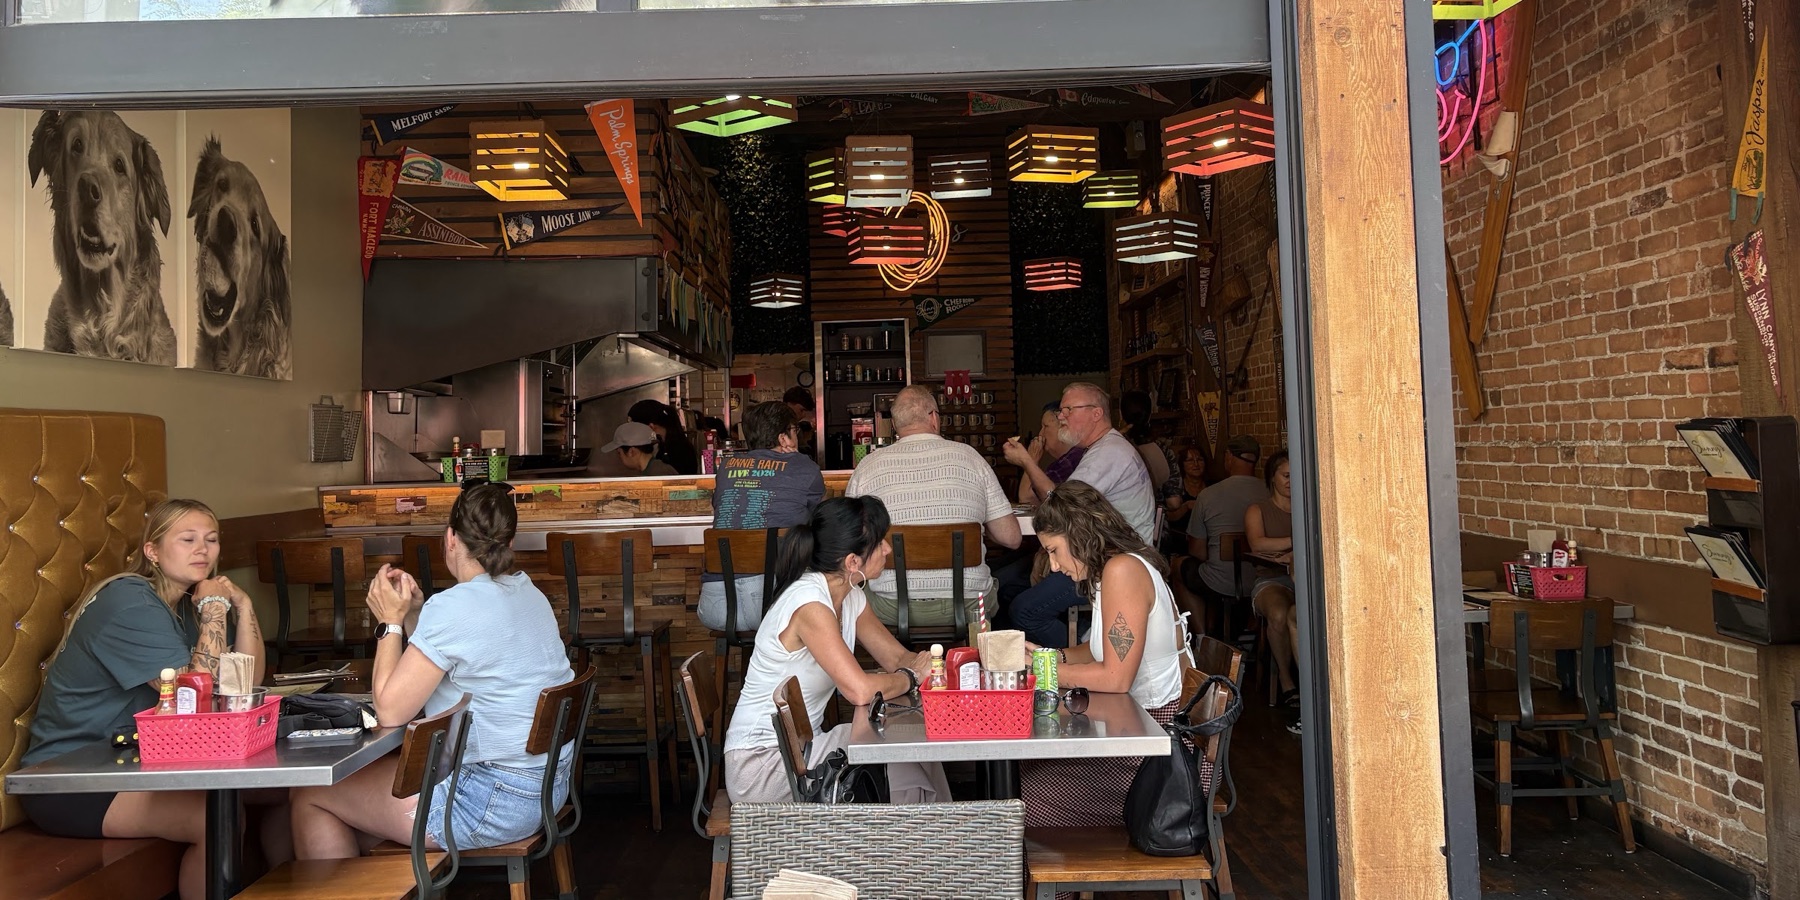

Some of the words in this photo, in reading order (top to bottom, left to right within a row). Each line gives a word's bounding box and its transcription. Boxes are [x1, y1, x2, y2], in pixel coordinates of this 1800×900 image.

[391, 111, 433, 132] MELFORT
[599, 105, 626, 142] Palm
[1746, 79, 1765, 146] Jasper
[610, 141, 634, 184] Springs
[443, 168, 471, 184] RAIN
[368, 202, 380, 225] FORT
[541, 212, 576, 234] MOOSE
[577, 210, 592, 223] JAW
[364, 225, 377, 259] MACLEOD
[418, 221, 466, 245] ASSINIBOIA
[1750, 293, 1769, 347] SUSPENSION
[1755, 288, 1770, 320] LYNN
[1766, 324, 1777, 363] CANYON
[727, 469, 750, 479] LIVE
[757, 459, 788, 472] RAITT
